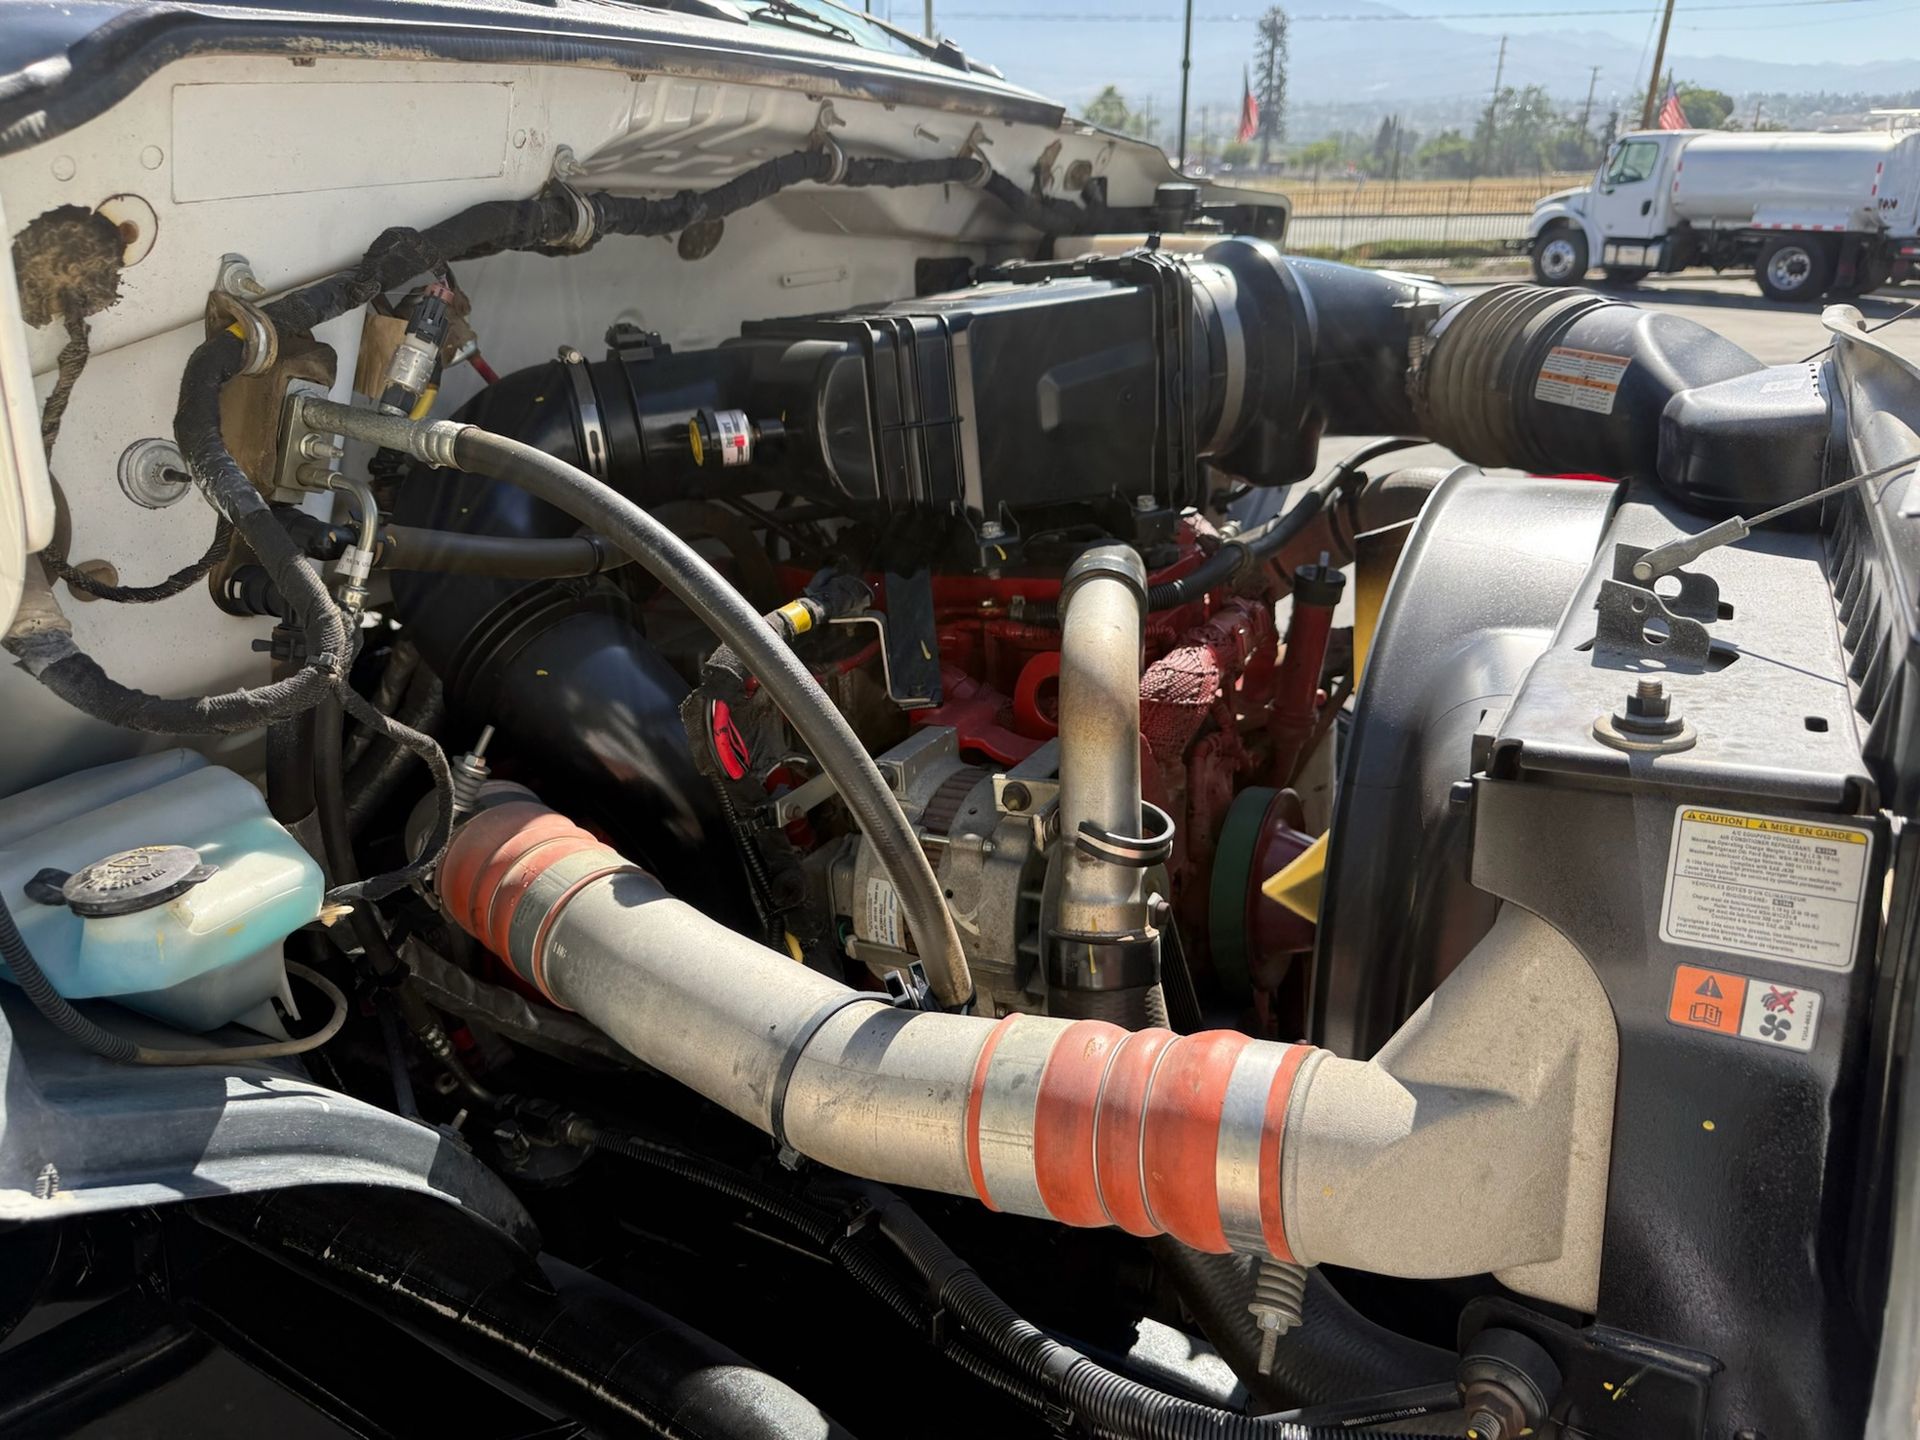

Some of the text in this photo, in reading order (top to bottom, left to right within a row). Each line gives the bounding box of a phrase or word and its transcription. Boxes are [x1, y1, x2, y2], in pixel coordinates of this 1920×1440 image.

[1699, 814, 1743, 825] CAUTION
[1770, 823, 1852, 840] MISE EN GARDE
